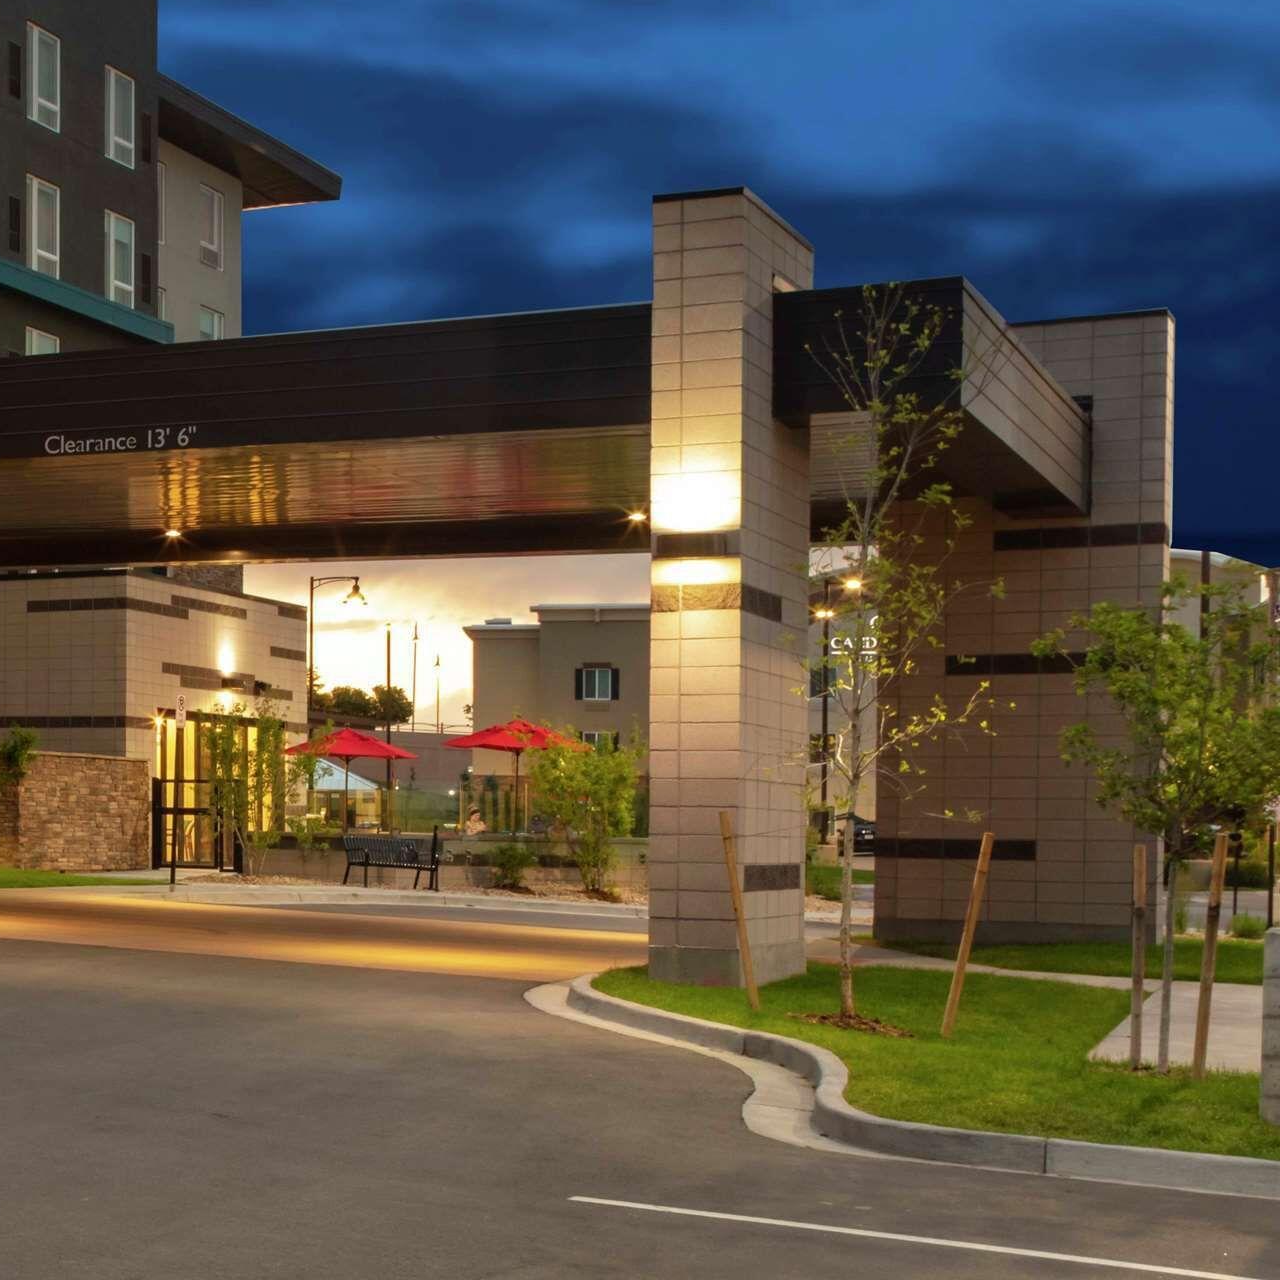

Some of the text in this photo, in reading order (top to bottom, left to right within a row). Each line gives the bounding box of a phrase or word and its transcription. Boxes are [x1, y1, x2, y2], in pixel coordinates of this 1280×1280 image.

[43, 425, 198, 455] Clearance 13' 6"
